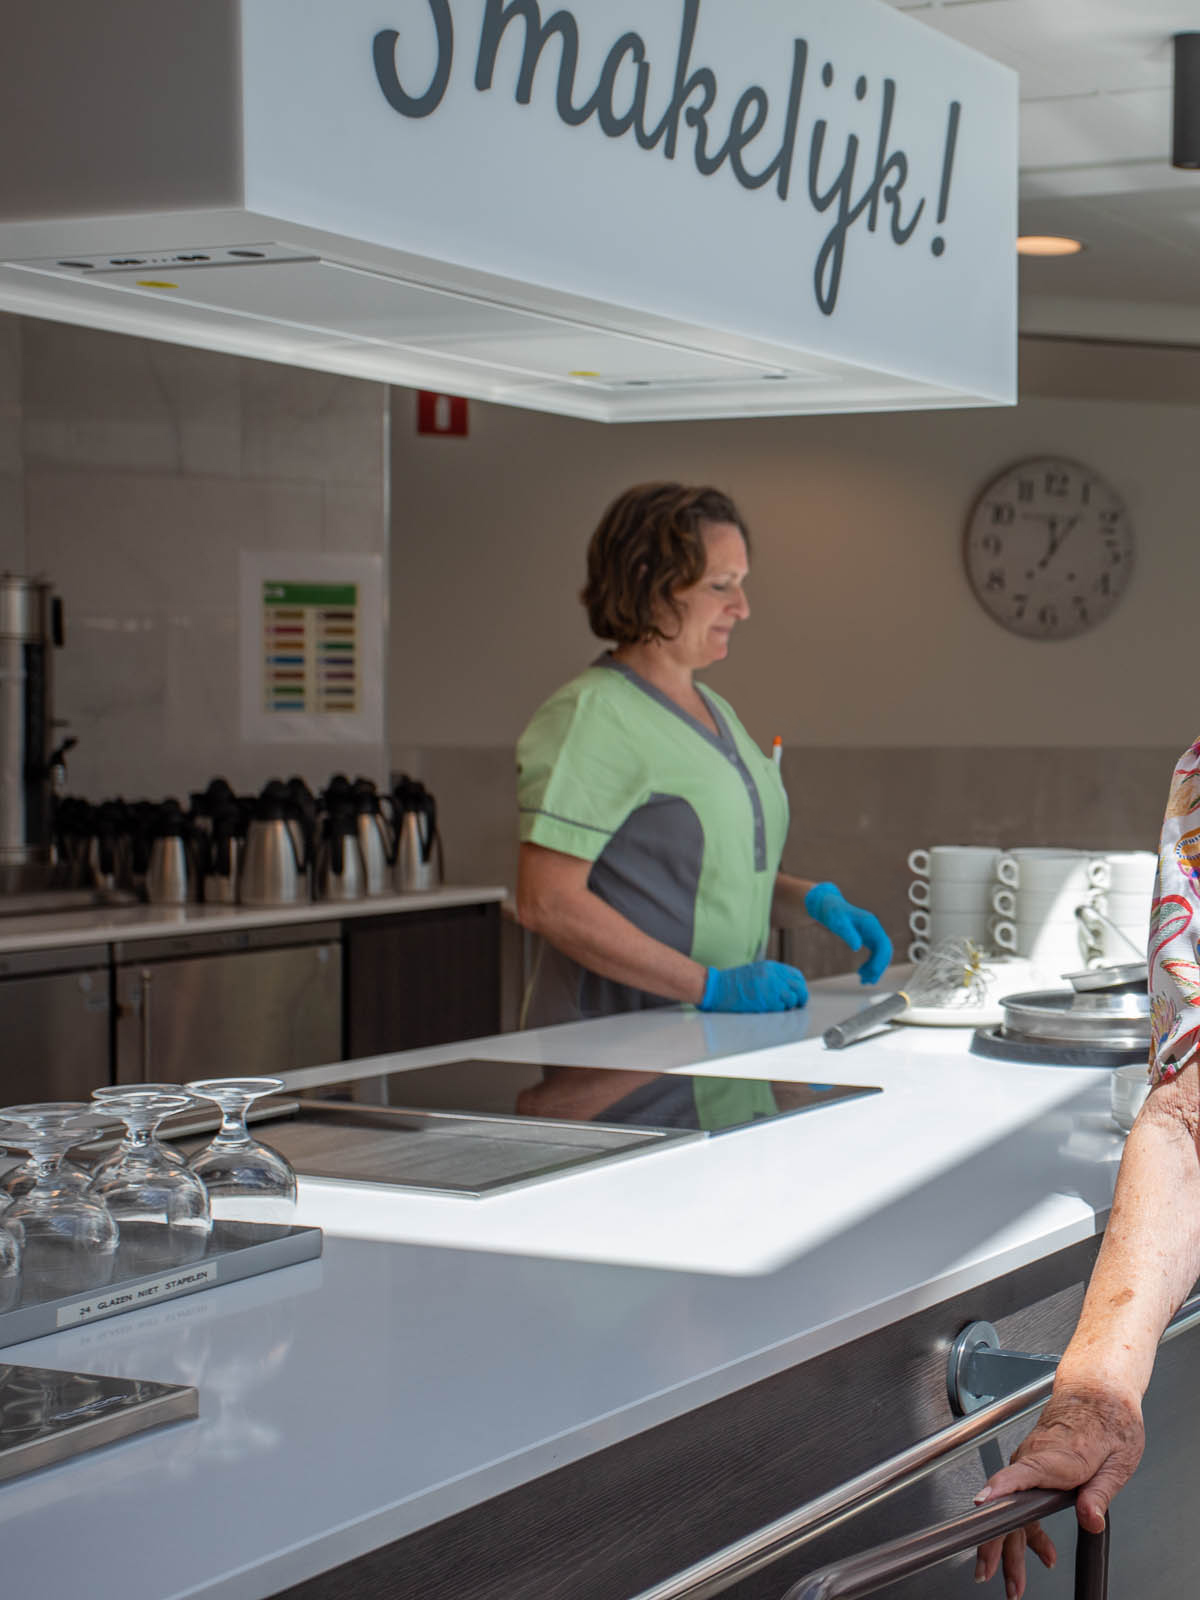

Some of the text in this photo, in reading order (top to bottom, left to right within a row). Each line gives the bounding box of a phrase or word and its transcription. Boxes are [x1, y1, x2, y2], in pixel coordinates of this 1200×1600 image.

[1044, 473, 1070, 497] 12
[79, 1271, 208, 1316] 24 GLAZEN NIET STAPELEN
